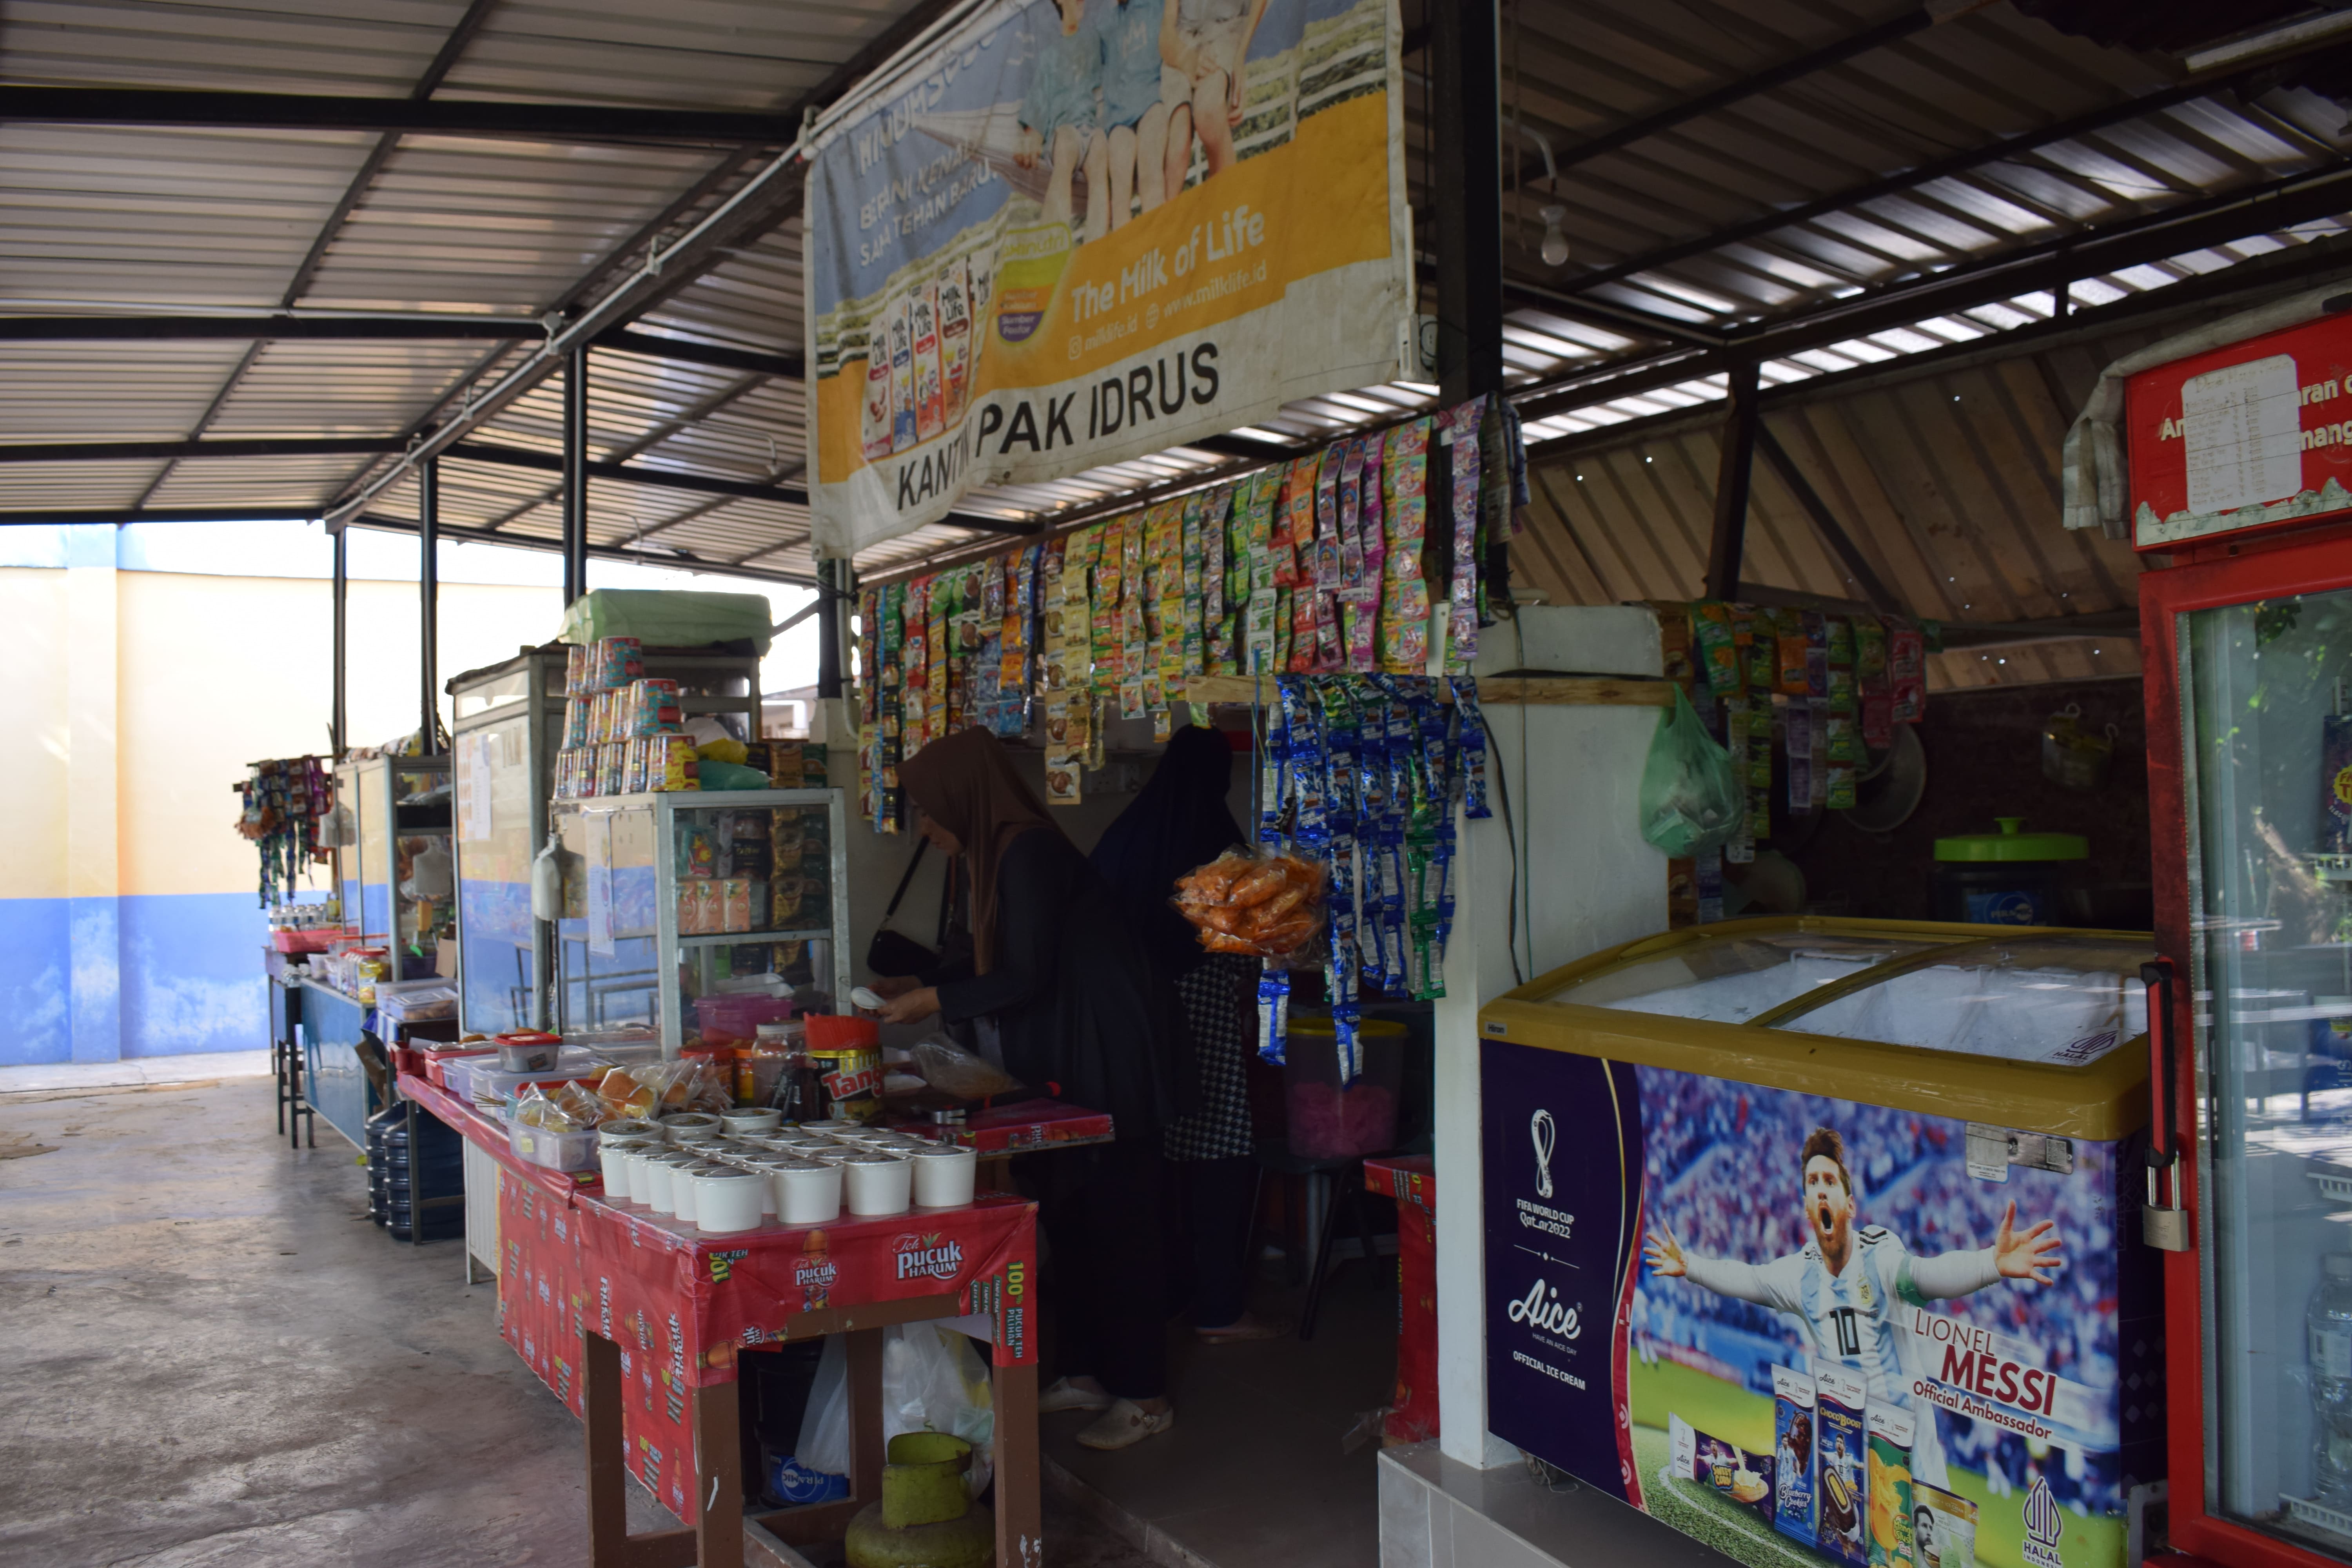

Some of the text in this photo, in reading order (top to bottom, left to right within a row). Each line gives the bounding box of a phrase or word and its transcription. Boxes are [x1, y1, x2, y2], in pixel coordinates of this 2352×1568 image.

[1071, 205, 1265, 323] The Milk of Life
[946, 301, 964, 321] Life
[1085, 259, 1267, 351] milklife.id www.milklife.id
[976, 391, 1076, 457] PAK
[1089, 342, 1219, 440] IDRUS
[2053, 1051, 2090, 1060] HALAL
[1517, 1198, 1574, 1225] FIFA WORLD CUP
[897, 1240, 963, 1279] pucuk
[909, 1262, 957, 1278] HARUM
[795, 1262, 837, 1286] pucuk
[803, 1276, 833, 1284] HARUM
[1508, 1279, 1581, 1340] Aice
[1007, 1308, 1015, 1347] PILIHAN
[1830, 1308, 1860, 1356] 10
[1915, 1308, 1994, 1357] LIONEL
[1014, 1340, 1023, 1359] TEH
[1532, 1332, 1577, 1356] HAVE AN AICE DAY
[1513, 1350, 1586, 1390] OFFICIAL ICE CREAM
[1819, 1373, 1835, 1385] Aice
[1940, 1344, 2056, 1416] MESSI
[1913, 1380, 2052, 1440] Official Ambassador
[1779, 1483, 1812, 1503] Blueberry
[1784, 1495, 1807, 1508] Cookies
[2024, 1541, 2062, 1565] HALAL
